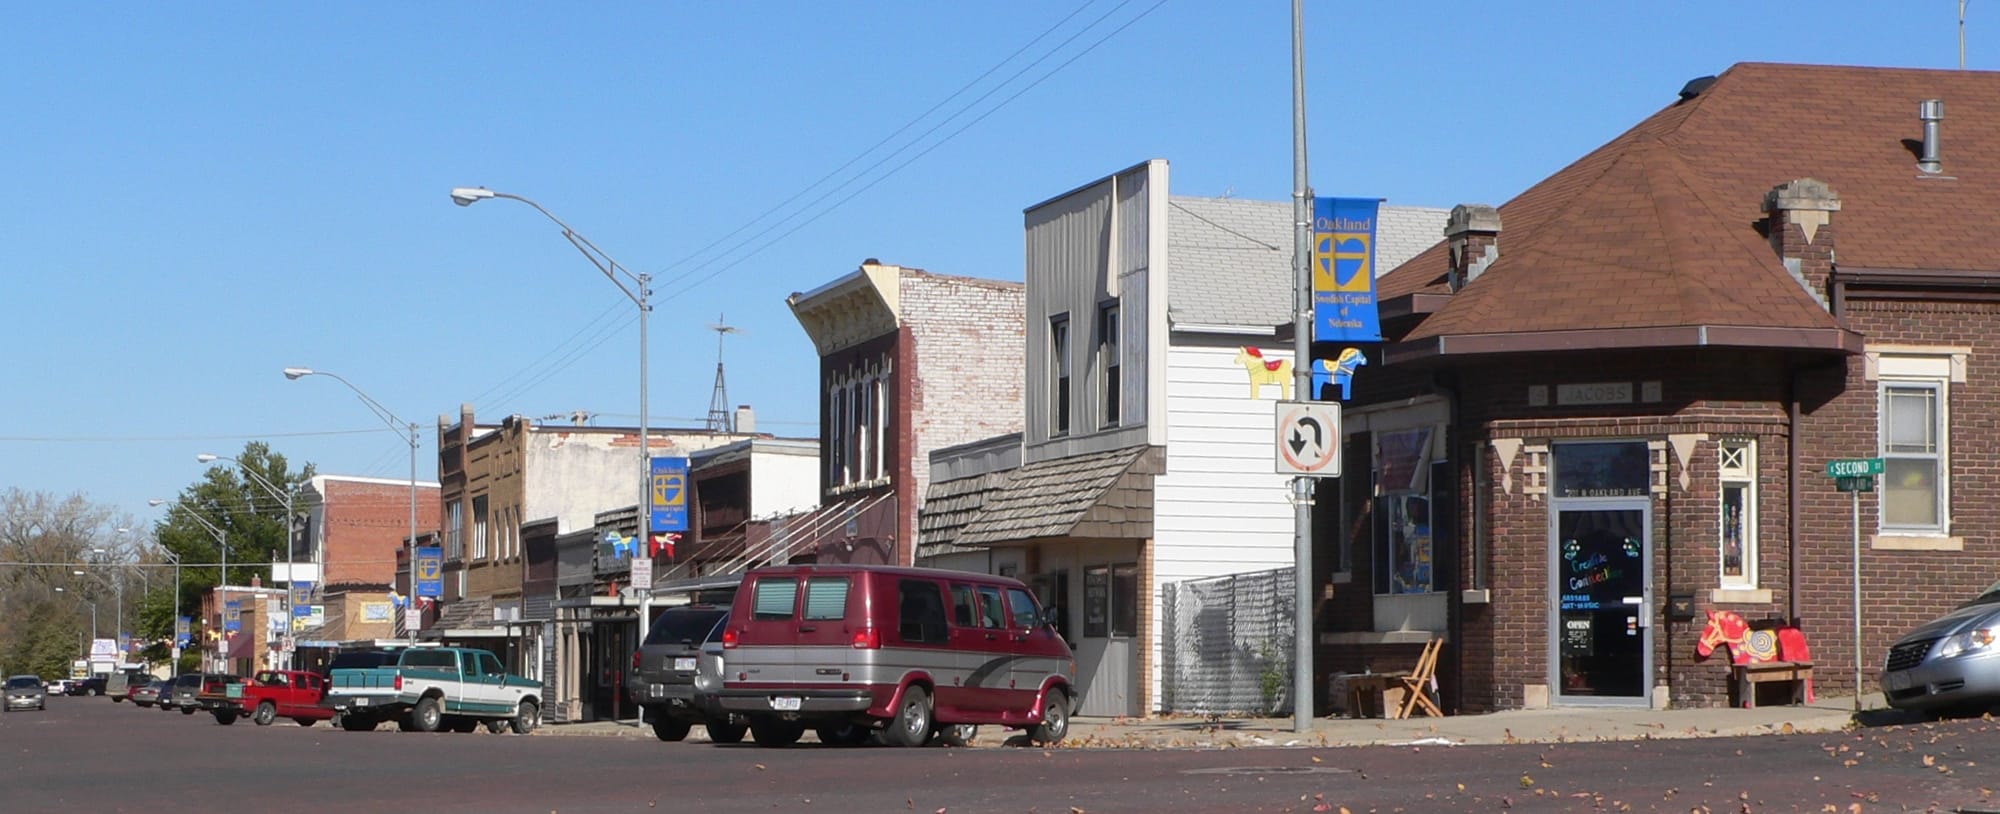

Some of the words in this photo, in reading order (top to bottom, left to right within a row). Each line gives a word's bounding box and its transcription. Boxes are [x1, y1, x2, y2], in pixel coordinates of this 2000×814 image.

[1317, 217, 1371, 231] Oakland
[1315, 293, 1344, 304] Swedish
[1345, 294, 1371, 307] Capital
[1340, 306, 1349, 317] of
[1328, 317, 1363, 329] Nebraska
[1566, 386, 1625, 402] JACOBS
[1835, 461, 1869, 475] SECOND
[1589, 488, 1624, 497] OAKLAND
[1628, 488, 1641, 497] AVE
[1567, 620, 1590, 629] OPEN
